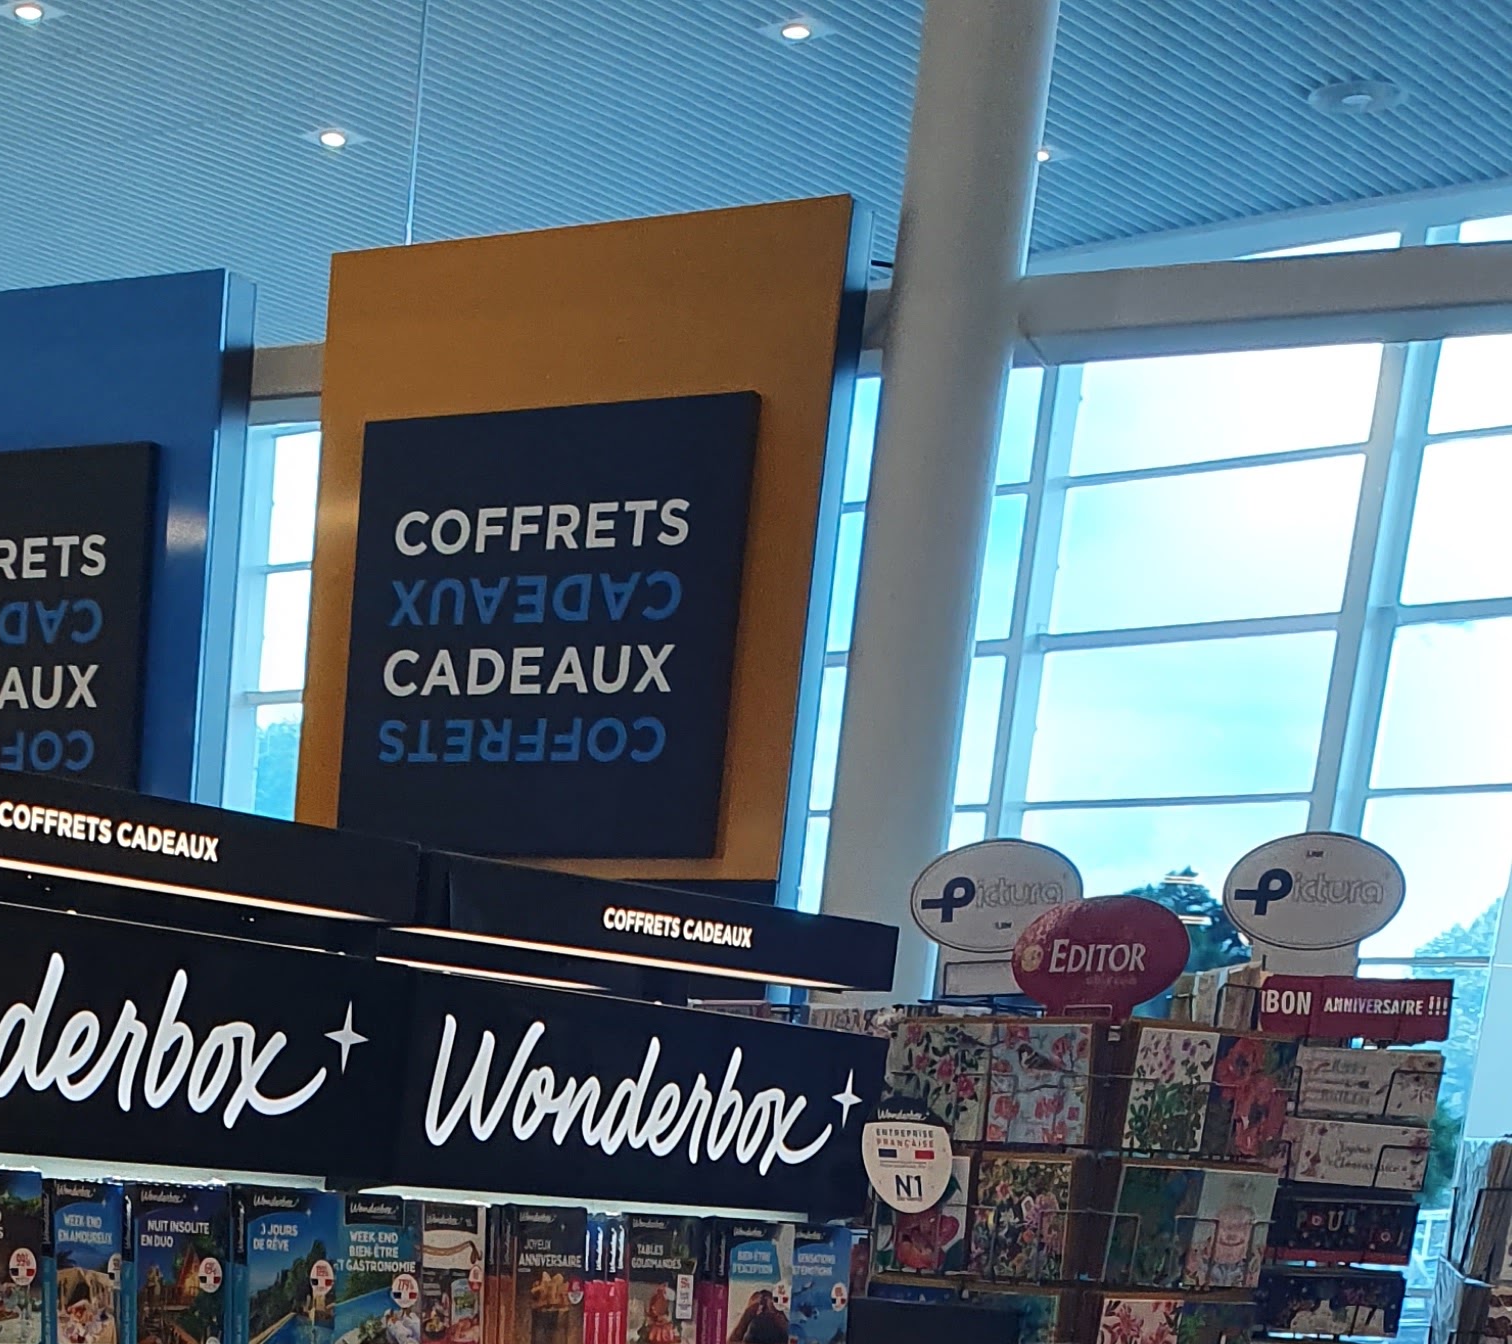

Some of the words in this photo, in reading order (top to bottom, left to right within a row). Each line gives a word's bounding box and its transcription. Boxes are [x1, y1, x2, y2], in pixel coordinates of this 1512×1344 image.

[395, 498, 690, 558] COFFRETS
[390, 570, 682, 627] CADEAUX
[383, 644, 675, 698] CADEAUX
[380, 716, 667, 764] COFFRETS
[117, 821, 219, 863] CADEAUX
[603, 906, 681, 940] COFFRETS
[682, 920, 752, 949] CADEAUX
[1049, 938, 1146, 973] EDITOR
[1324, 997, 1423, 1016] ANNIVERSAIRE
[424, 1012, 833, 1177] Wonderbox
[876, 1128, 933, 1138] ENTREPRISE
[876, 1139, 934, 1148] FRANÇAISE
[519, 1252, 582, 1270] ANNIVERSAIRE
